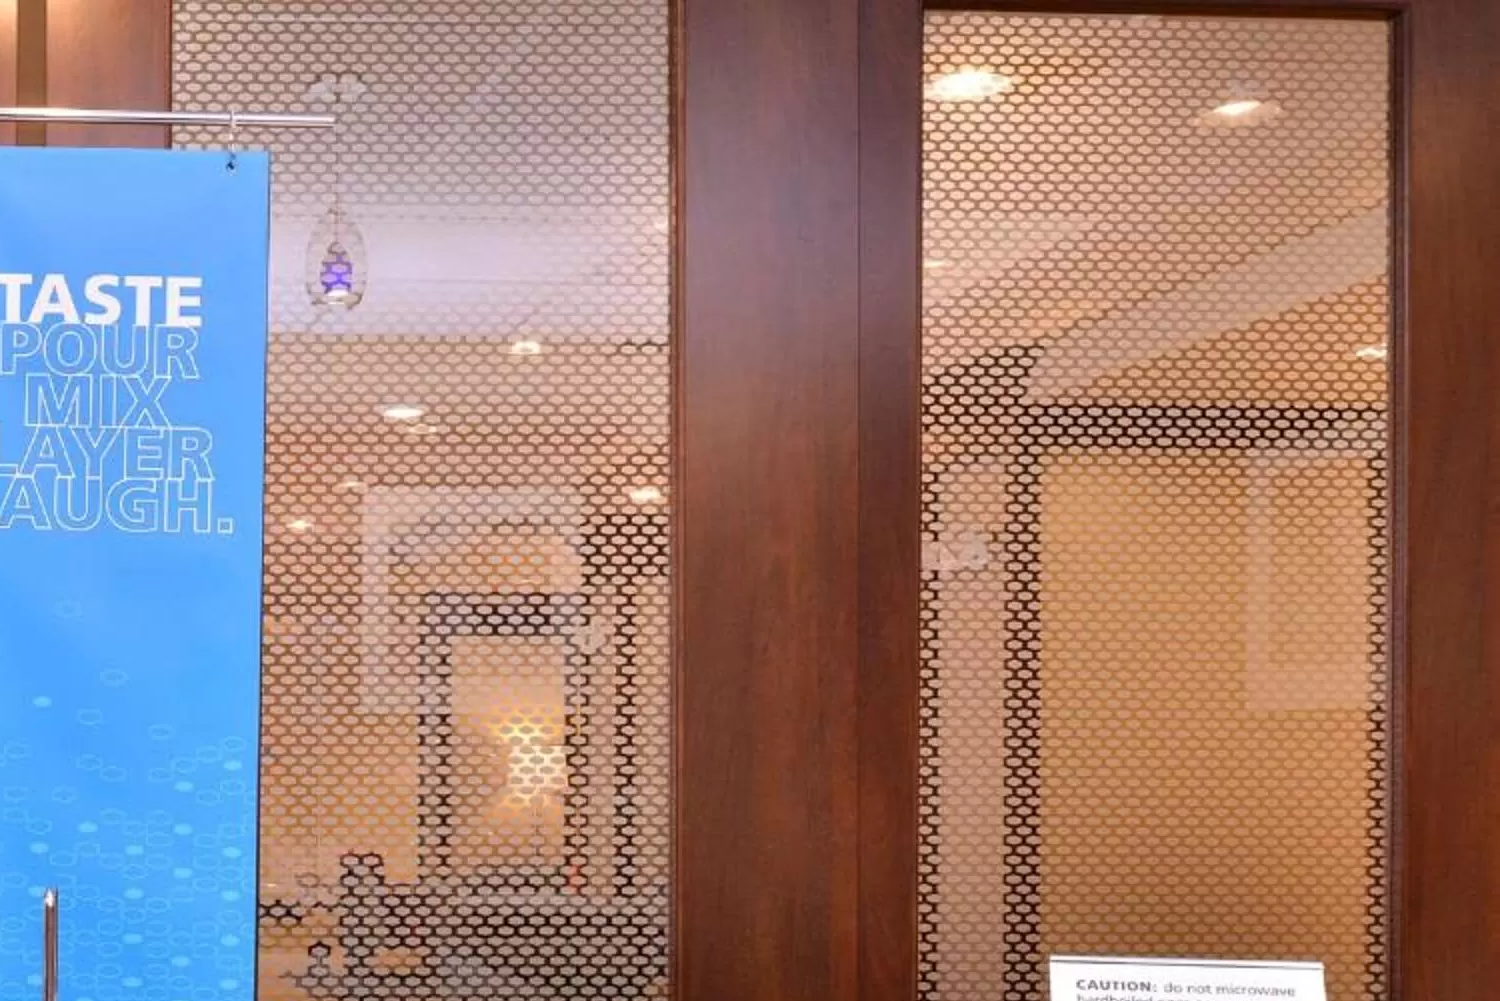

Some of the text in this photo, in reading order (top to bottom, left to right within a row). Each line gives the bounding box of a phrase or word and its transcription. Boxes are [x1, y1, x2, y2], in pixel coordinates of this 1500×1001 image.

[0, 322, 200, 379] POUR
[24, 373, 171, 428] MIX
[1075, 979, 1296, 998] CAUTION: do not microwave
